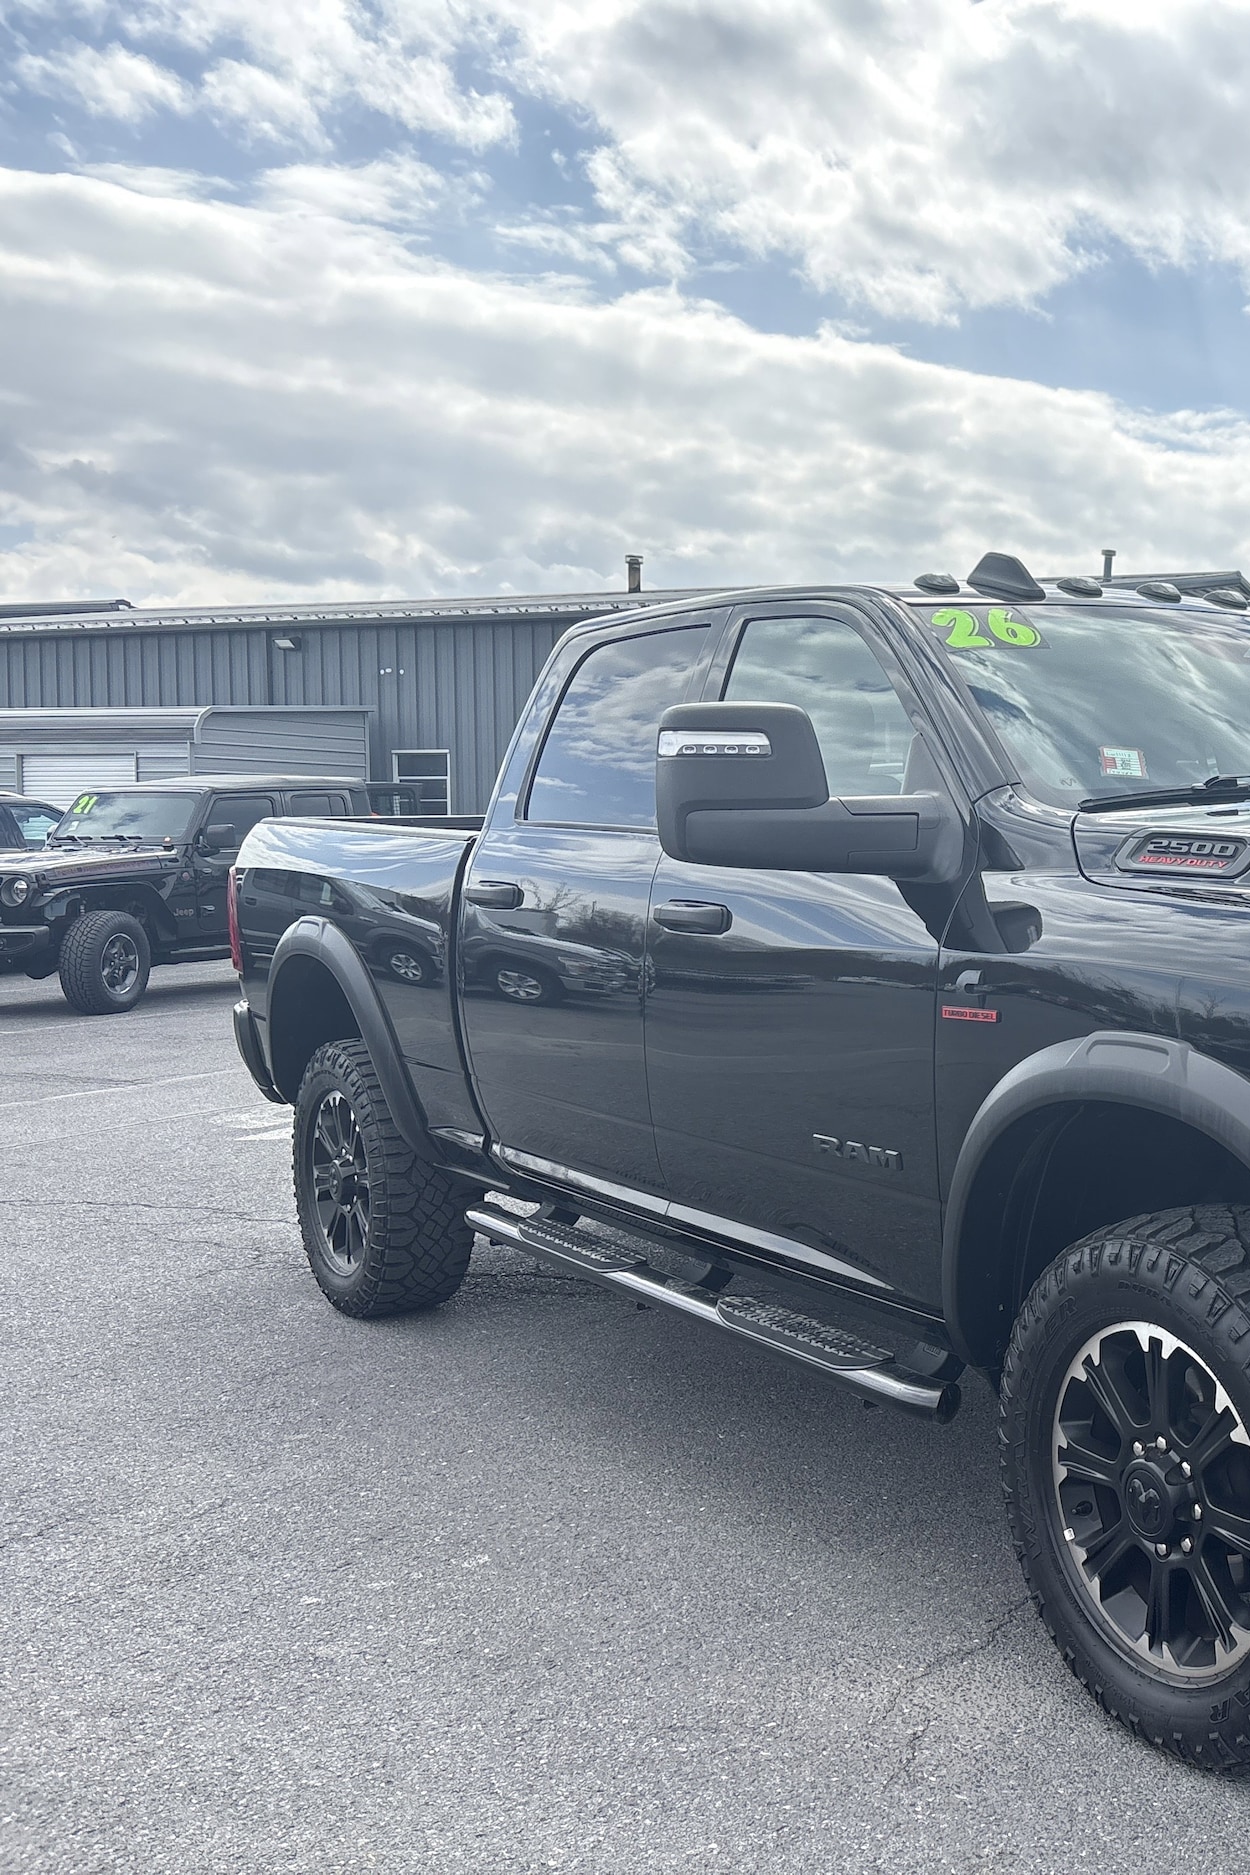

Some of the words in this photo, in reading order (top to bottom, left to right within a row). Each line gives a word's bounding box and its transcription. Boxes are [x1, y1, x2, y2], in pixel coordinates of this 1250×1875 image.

[931, 608, 1041, 648] 26
[73, 796, 98, 814] 21
[1147, 839, 1239, 858] 2500
[1138, 855, 1187, 866] HEAVY
[1186, 858, 1230, 869] DUTY
[174, 908, 195, 917] Jeep
[943, 1008, 968, 1018] TURBO
[968, 1011, 996, 1021] DIESEL
[812, 1133, 904, 1171] RAM
